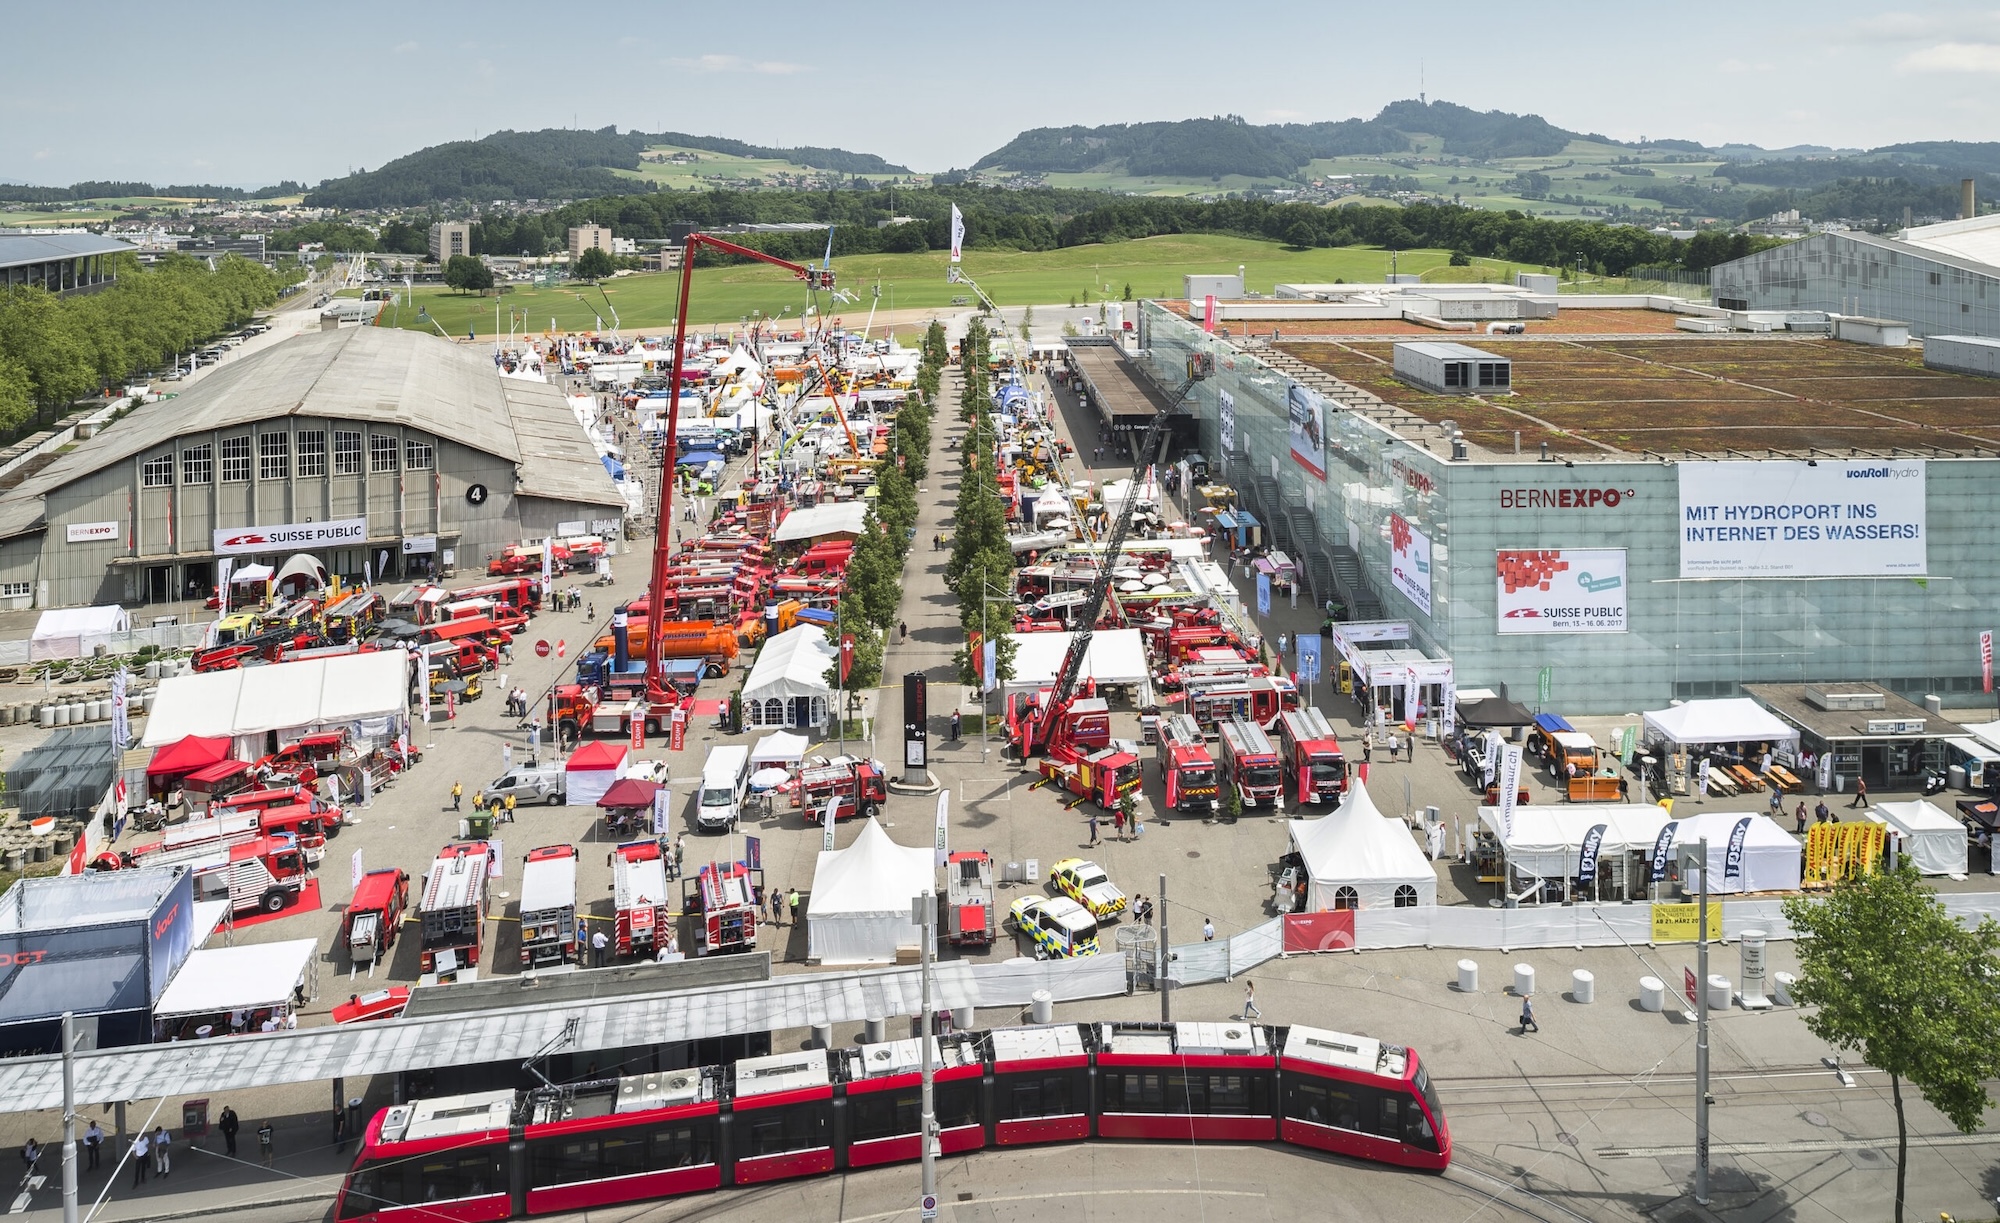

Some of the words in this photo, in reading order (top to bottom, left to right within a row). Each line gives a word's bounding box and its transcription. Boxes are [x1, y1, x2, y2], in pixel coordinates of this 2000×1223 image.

[1846, 467, 1919, 480] vonRollhydro
[471, 487, 481, 501] 4
[1501, 488, 1621, 508] BERNEXPO
[1686, 506, 1719, 521] MIT
[1724, 504, 1842, 520] HYDROPORT
[1847, 503, 1877, 519] INS
[70, 527, 111, 536] BERNEXPO
[269, 530, 313, 543] SUISSE
[317, 525, 362, 540] PUBLIC
[1686, 526, 1778, 542] INTERNET
[1784, 525, 1820, 540] DES
[1826, 524, 1919, 540] WASSERS!
[1543, 607, 1581, 618] SUISSE
[1584, 606, 1623, 617] PUBLIC
[1552, 620, 1572, 628] Bern,
[1607, 619, 1623, 627] 2017
[1505, 750, 1519, 839] hermannbaur.ch
[1861, 825, 1871, 865] ALLIANCE
[154, 902, 179, 941] VOGT
[0, 950, 47, 967] OGT
